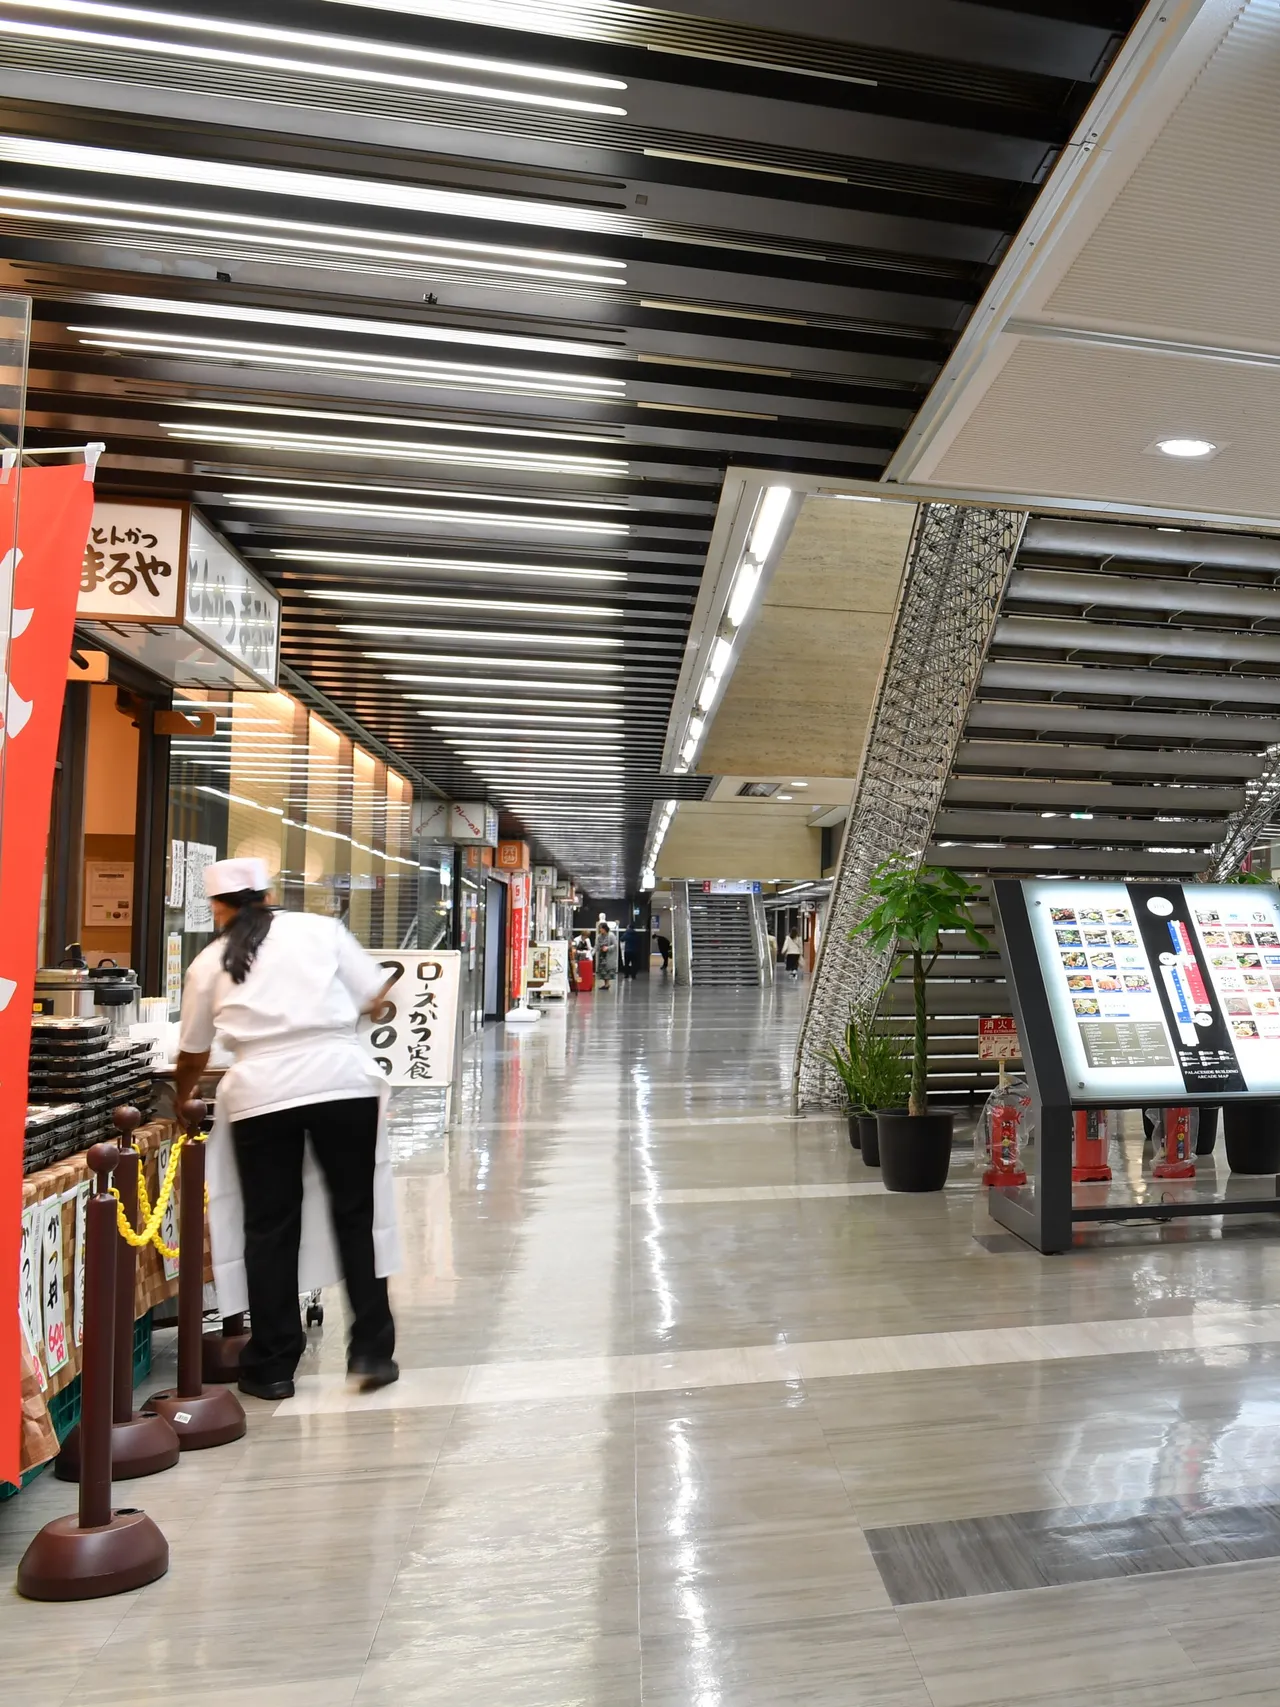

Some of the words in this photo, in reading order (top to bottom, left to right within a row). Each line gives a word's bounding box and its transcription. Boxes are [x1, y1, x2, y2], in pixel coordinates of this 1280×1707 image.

[91, 526, 158, 548] とんかつ
[80, 544, 171, 597] まるや
[404, 961, 443, 1079] ロースかつ定食
